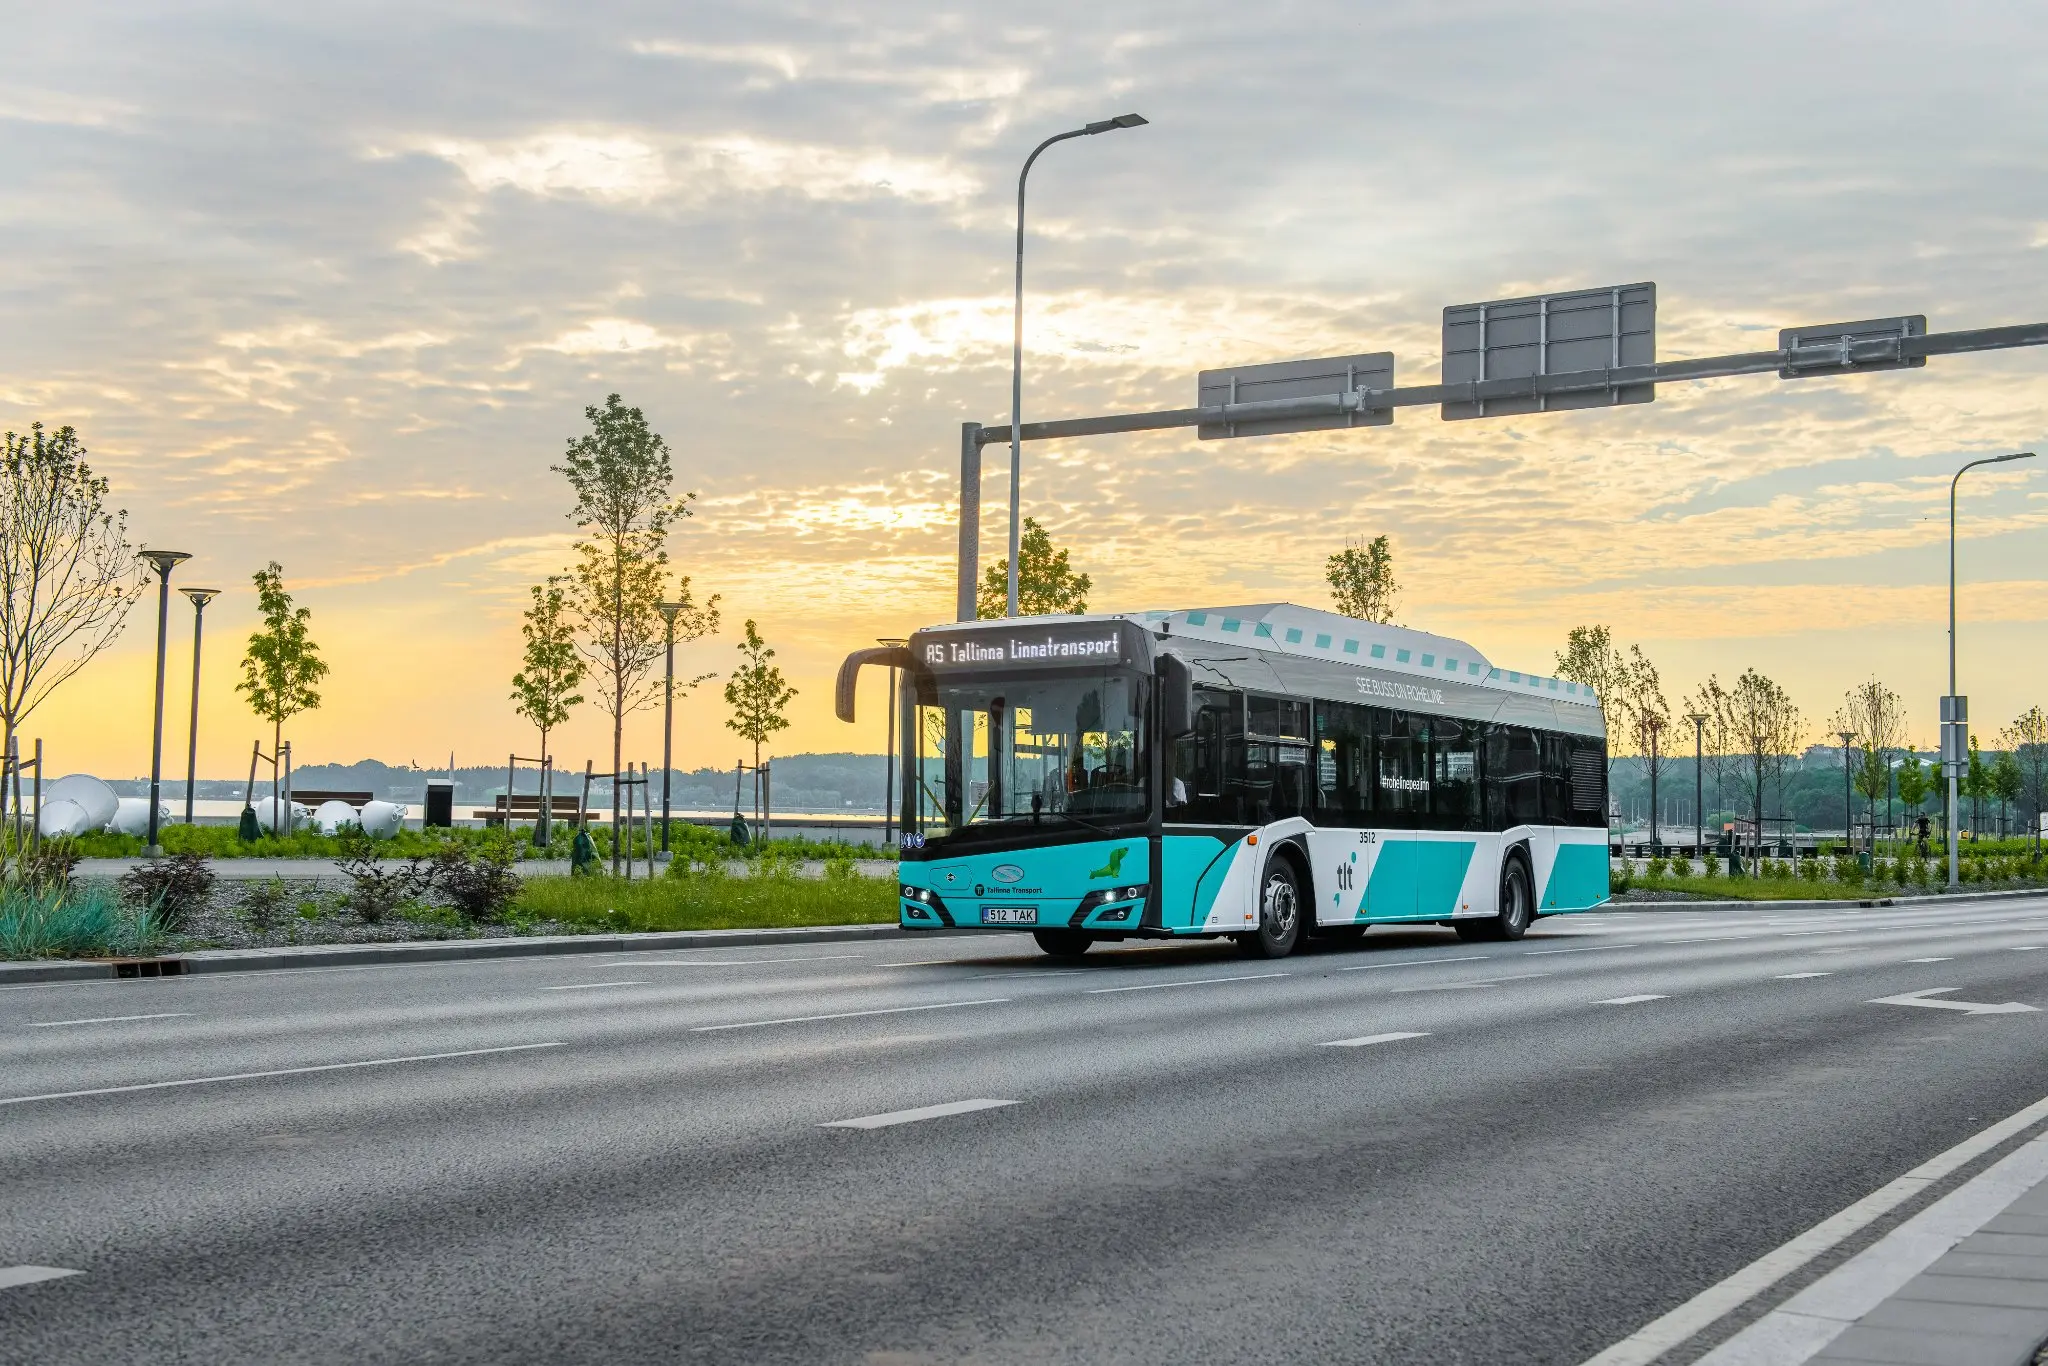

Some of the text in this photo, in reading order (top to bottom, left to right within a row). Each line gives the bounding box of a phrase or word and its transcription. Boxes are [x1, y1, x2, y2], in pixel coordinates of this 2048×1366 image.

[950, 642, 1004, 662] Tallinna
[1010, 632, 1118, 659] Linnatransport
[1356, 676, 1373, 694] SEE
[1372, 680, 1395, 698] BUSS
[1394, 683, 1408, 700] ON
[1359, 831, 1376, 844] 3512
[1336, 861, 1353, 891] tlt
[987, 886, 1043, 895] Tallinna Transport
[990, 909, 1007, 920] 512
[1012, 909, 1033, 920] TAK
